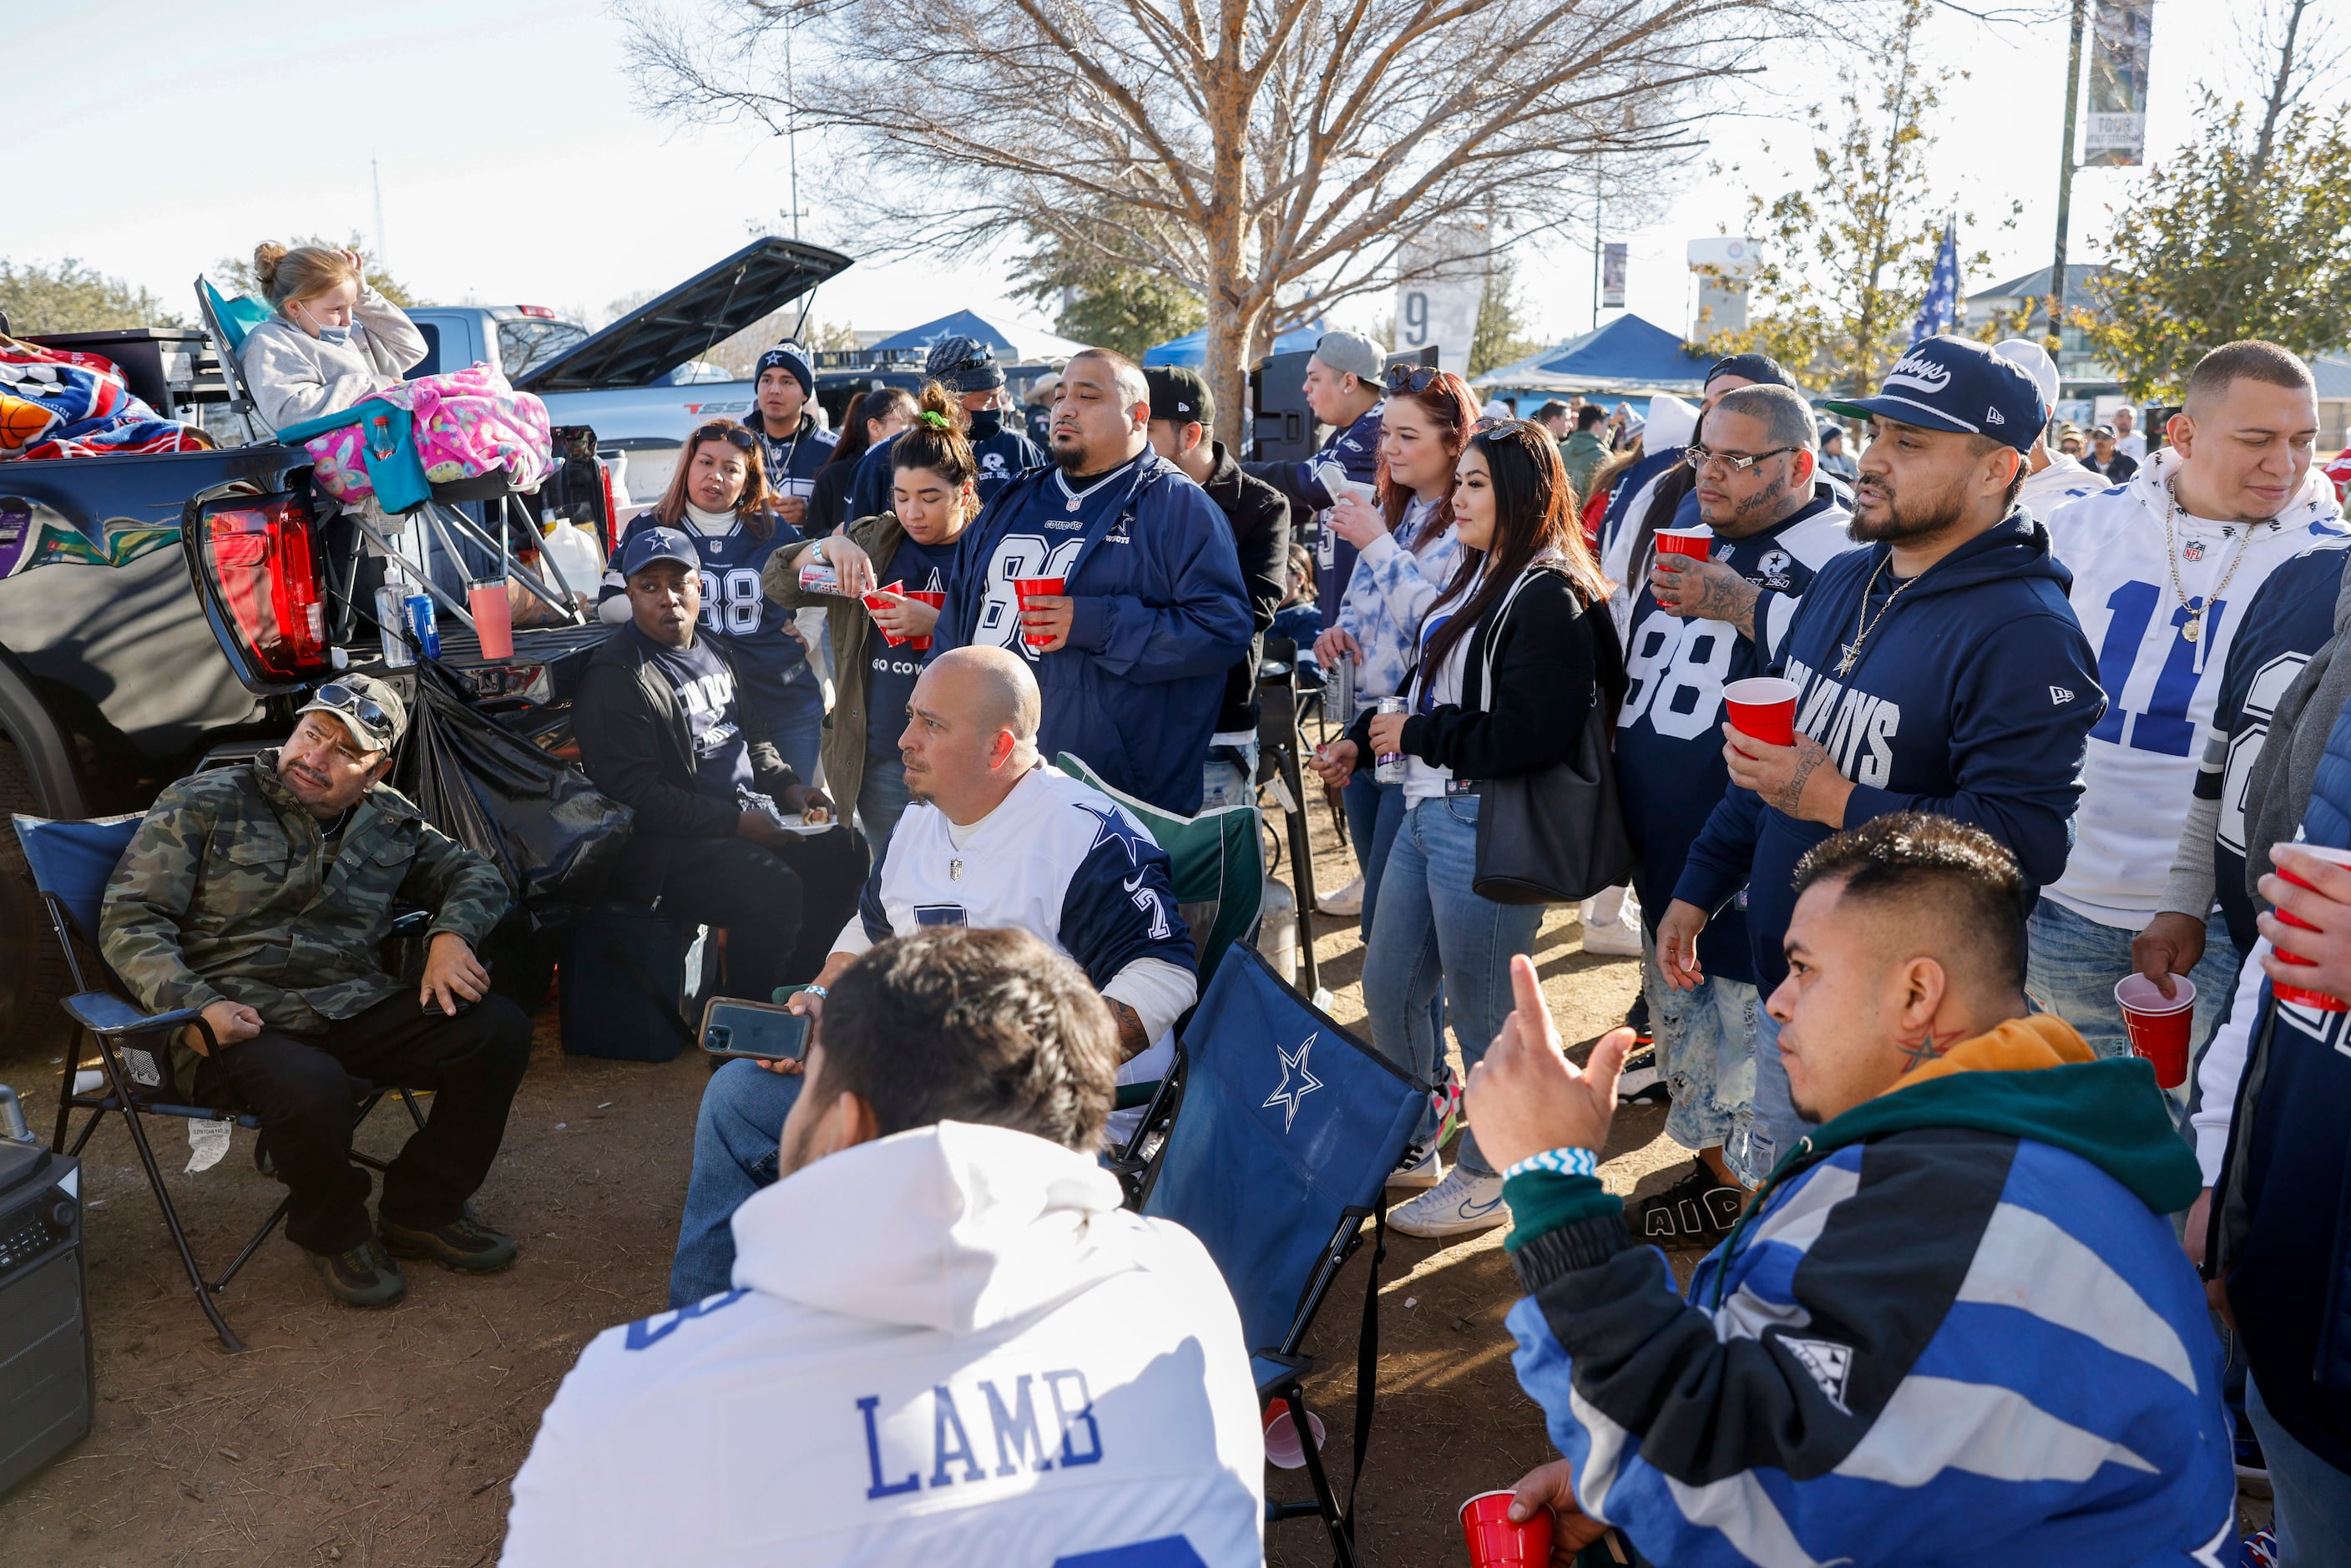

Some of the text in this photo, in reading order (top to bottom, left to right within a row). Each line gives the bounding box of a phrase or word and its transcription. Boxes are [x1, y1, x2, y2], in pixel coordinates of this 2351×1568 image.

[1405, 291, 1428, 346] 9
[2184, 547, 2202, 560] NFL
[1765, 577, 1791, 589] 1960
[872, 658, 888, 671] GO
[1616, 609, 1738, 741] 88
[2087, 579, 2227, 758] 11
[856, 1367, 1104, 1500] LAMB
